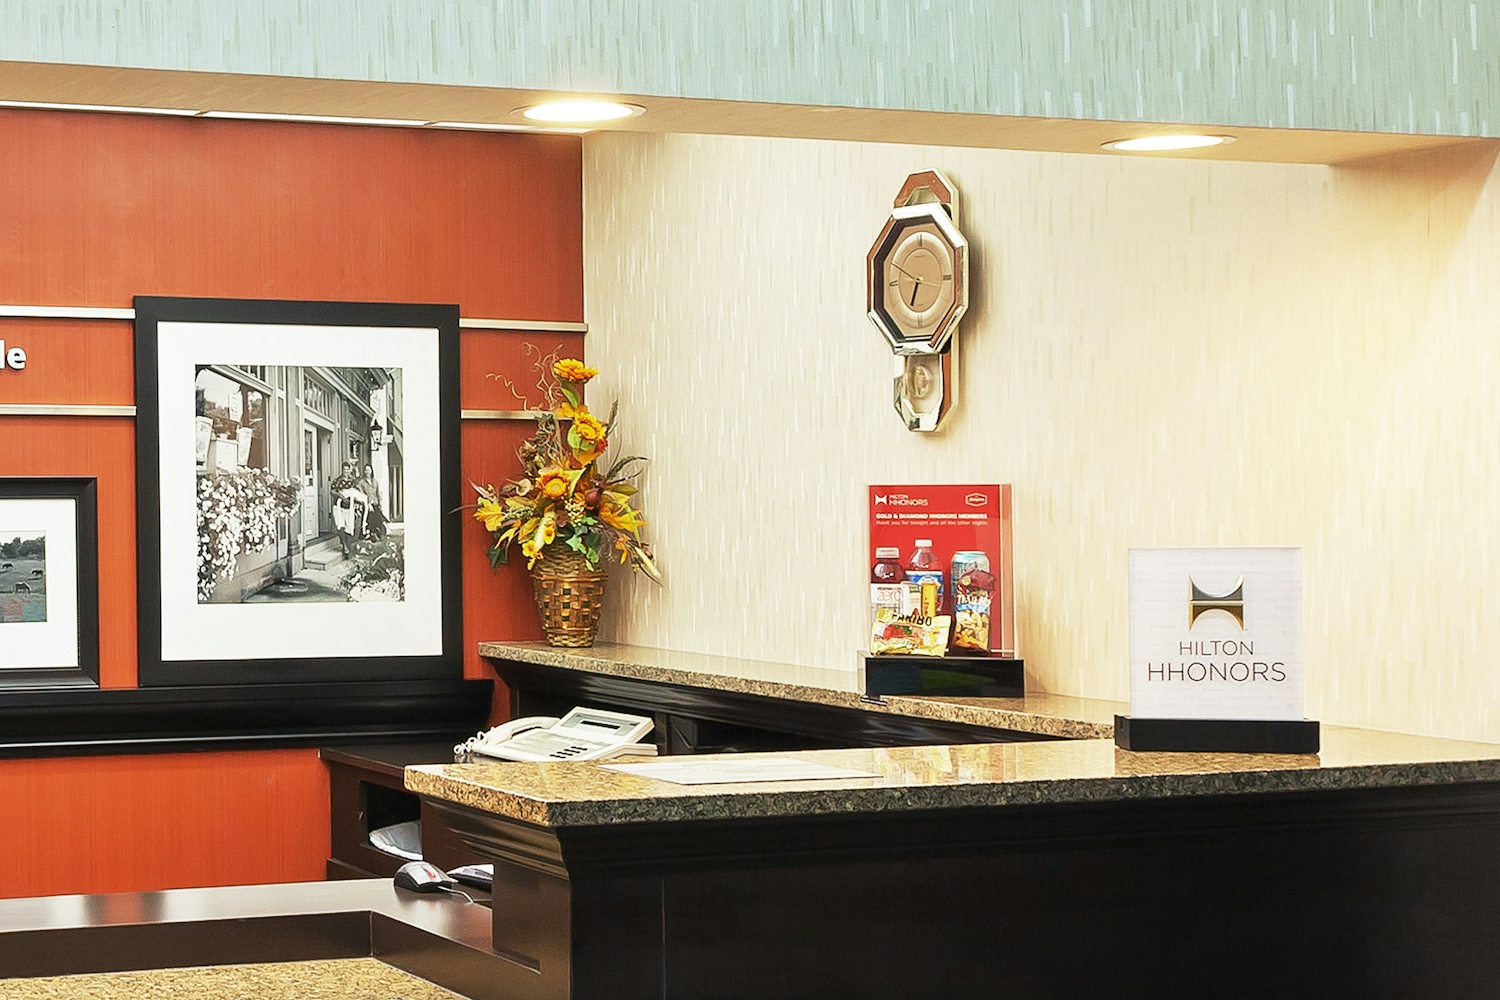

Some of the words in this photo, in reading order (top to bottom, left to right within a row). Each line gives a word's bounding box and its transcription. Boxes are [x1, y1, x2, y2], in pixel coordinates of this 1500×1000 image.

[889, 498, 929, 506] HHONORS
[877, 590, 901, 601] zero
[1179, 640, 1254, 656] HILTON
[1148, 662, 1286, 682] HHONORS
